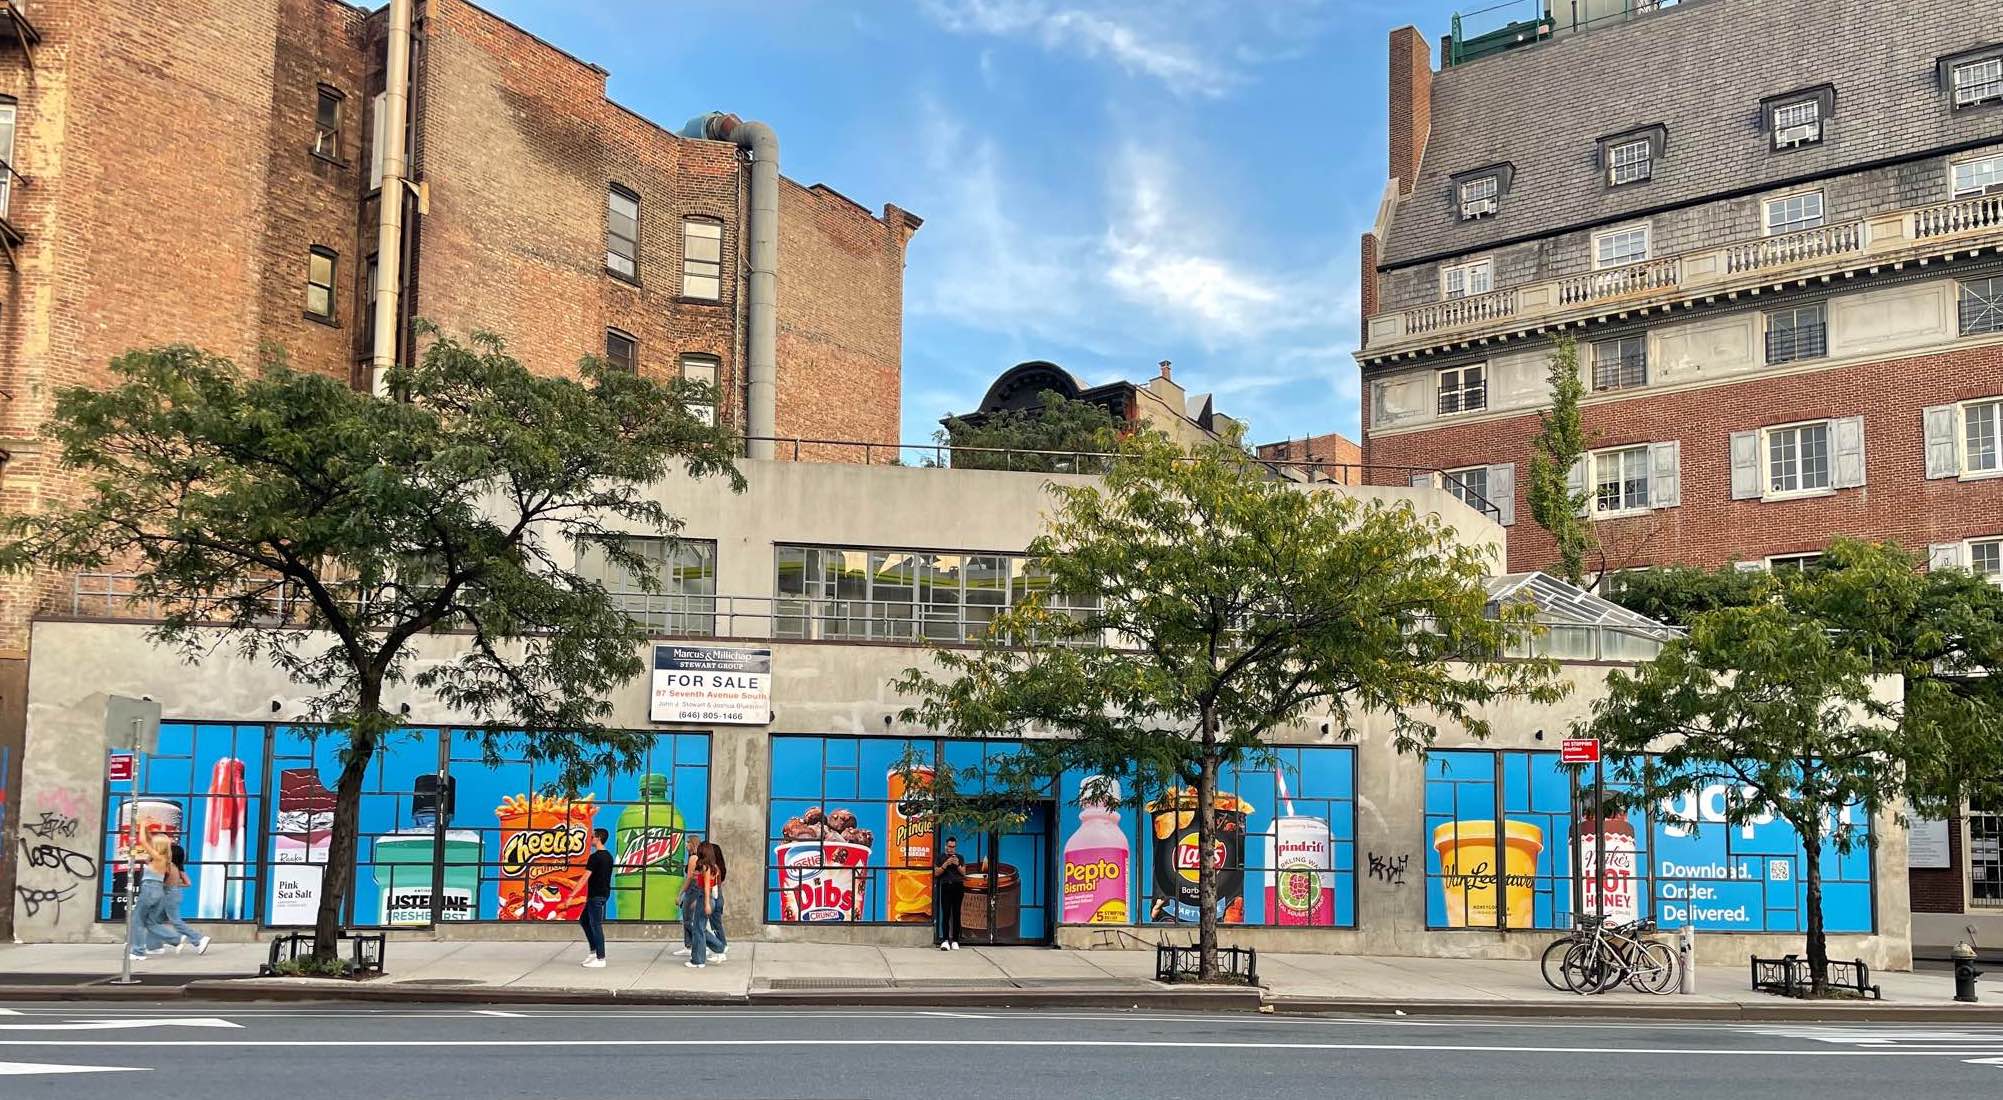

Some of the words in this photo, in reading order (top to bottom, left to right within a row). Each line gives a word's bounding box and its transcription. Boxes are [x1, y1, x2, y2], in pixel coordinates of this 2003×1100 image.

[673, 648, 704, 659] Marcus
[704, 652, 714, 662] &
[713, 650, 752, 662] Millichap
[680, 661, 716, 669] STEWART
[718, 662, 744, 670] GROUP
[667, 674, 704, 687] FOR
[712, 676, 759, 689] SALE
[669, 690, 704, 698] Seventh
[707, 691, 740, 699] Avenue
[741, 692, 767, 700] South
[679, 711, 700, 719] (646)
[703, 711, 743, 720] 805-1466
[896, 820, 934, 846] Pringle
[503, 824, 587, 876] Cheetos
[1278, 841, 1325, 856] pindrift
[1065, 858, 1120, 882] Pepto
[1662, 861, 1752, 879] Download.
[279, 880, 299, 890] Pink
[1064, 880, 1097, 894] Bismol
[1585, 868, 1630, 893] HOT
[278, 890, 293, 899] Sea
[295, 890, 312, 899] Salt
[794, 878, 853, 911] Dibs
[1662, 883, 1718, 900] Order.
[386, 895, 469, 912] LISTEINE
[1586, 894, 1631, 908] HNEY
[810, 912, 839, 920] CRUNCH
[1096, 911, 1104, 922] 5
[1663, 905, 1750, 922] Delivered.
